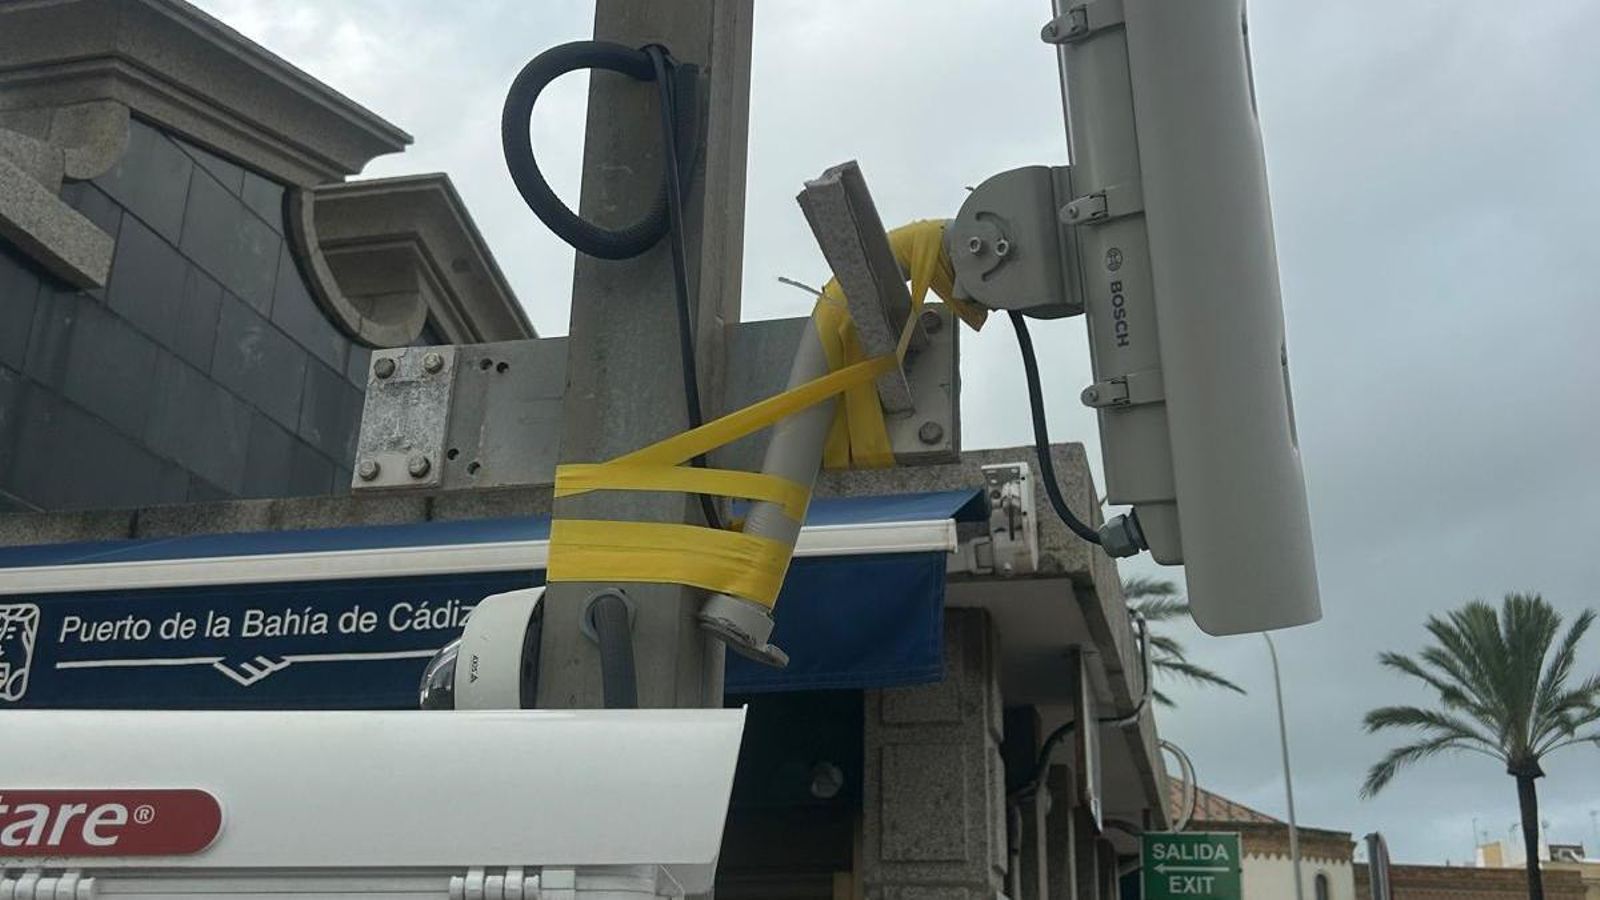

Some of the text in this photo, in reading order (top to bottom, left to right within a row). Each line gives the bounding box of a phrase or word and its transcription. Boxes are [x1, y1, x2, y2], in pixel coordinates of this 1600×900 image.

[1110, 279, 1130, 348] BOSCH
[59, 599, 476, 643] Puerto de la Bahía de Cádiz
[1151, 843, 1229, 862] SALIDA
[1169, 876, 1215, 895] EXIT
